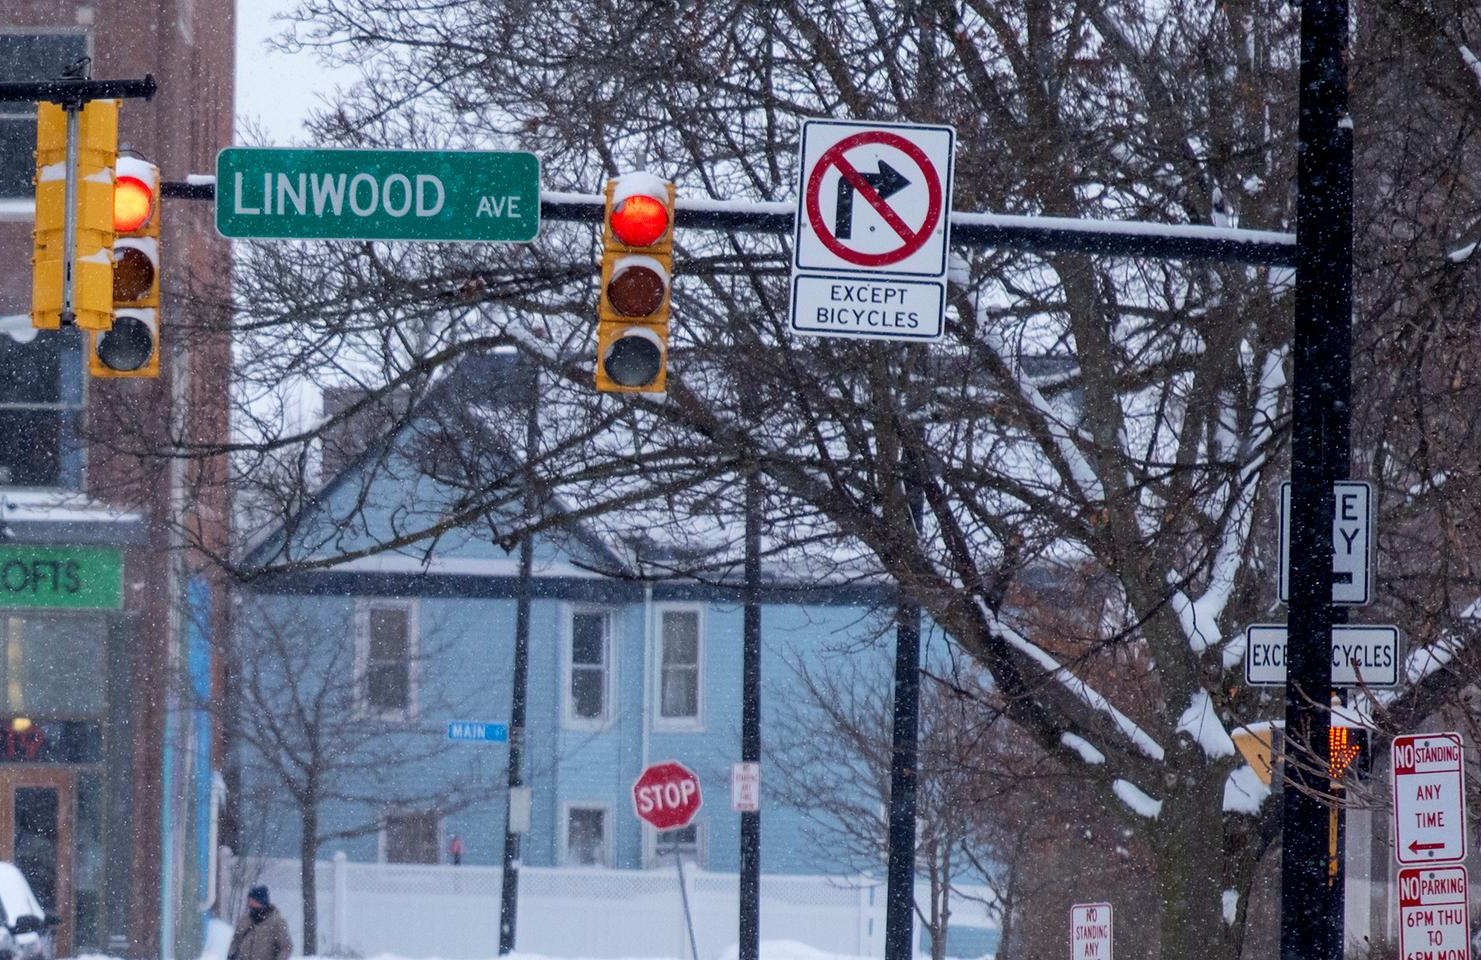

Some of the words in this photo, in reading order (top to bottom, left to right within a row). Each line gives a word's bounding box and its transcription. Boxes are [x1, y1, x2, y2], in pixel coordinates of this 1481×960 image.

[234, 171, 446, 218] LINWOOD
[475, 195, 522, 218] AVE
[830, 284, 908, 305] EXCEPT
[816, 306, 920, 329] BICYCLES
[1332, 644, 1392, 667] CYCLES
[452, 723, 486, 738] MAIN
[1396, 745, 1413, 768] NO
[1415, 746, 1458, 763] STANDING
[639, 780, 696, 813] STOP
[1416, 784, 1441, 800] ANY
[1415, 812, 1444, 828] TIME
[1401, 877, 1419, 901] NO
[1421, 878, 1464, 896] PARKING
[1086, 908, 1097, 922] NO
[1407, 911, 1434, 928] 6PM
[1437, 909, 1463, 925] THU
[1076, 925, 1108, 940] STANDING
[1427, 930, 1443, 947] TO
[1084, 943, 1099, 957] ANY
